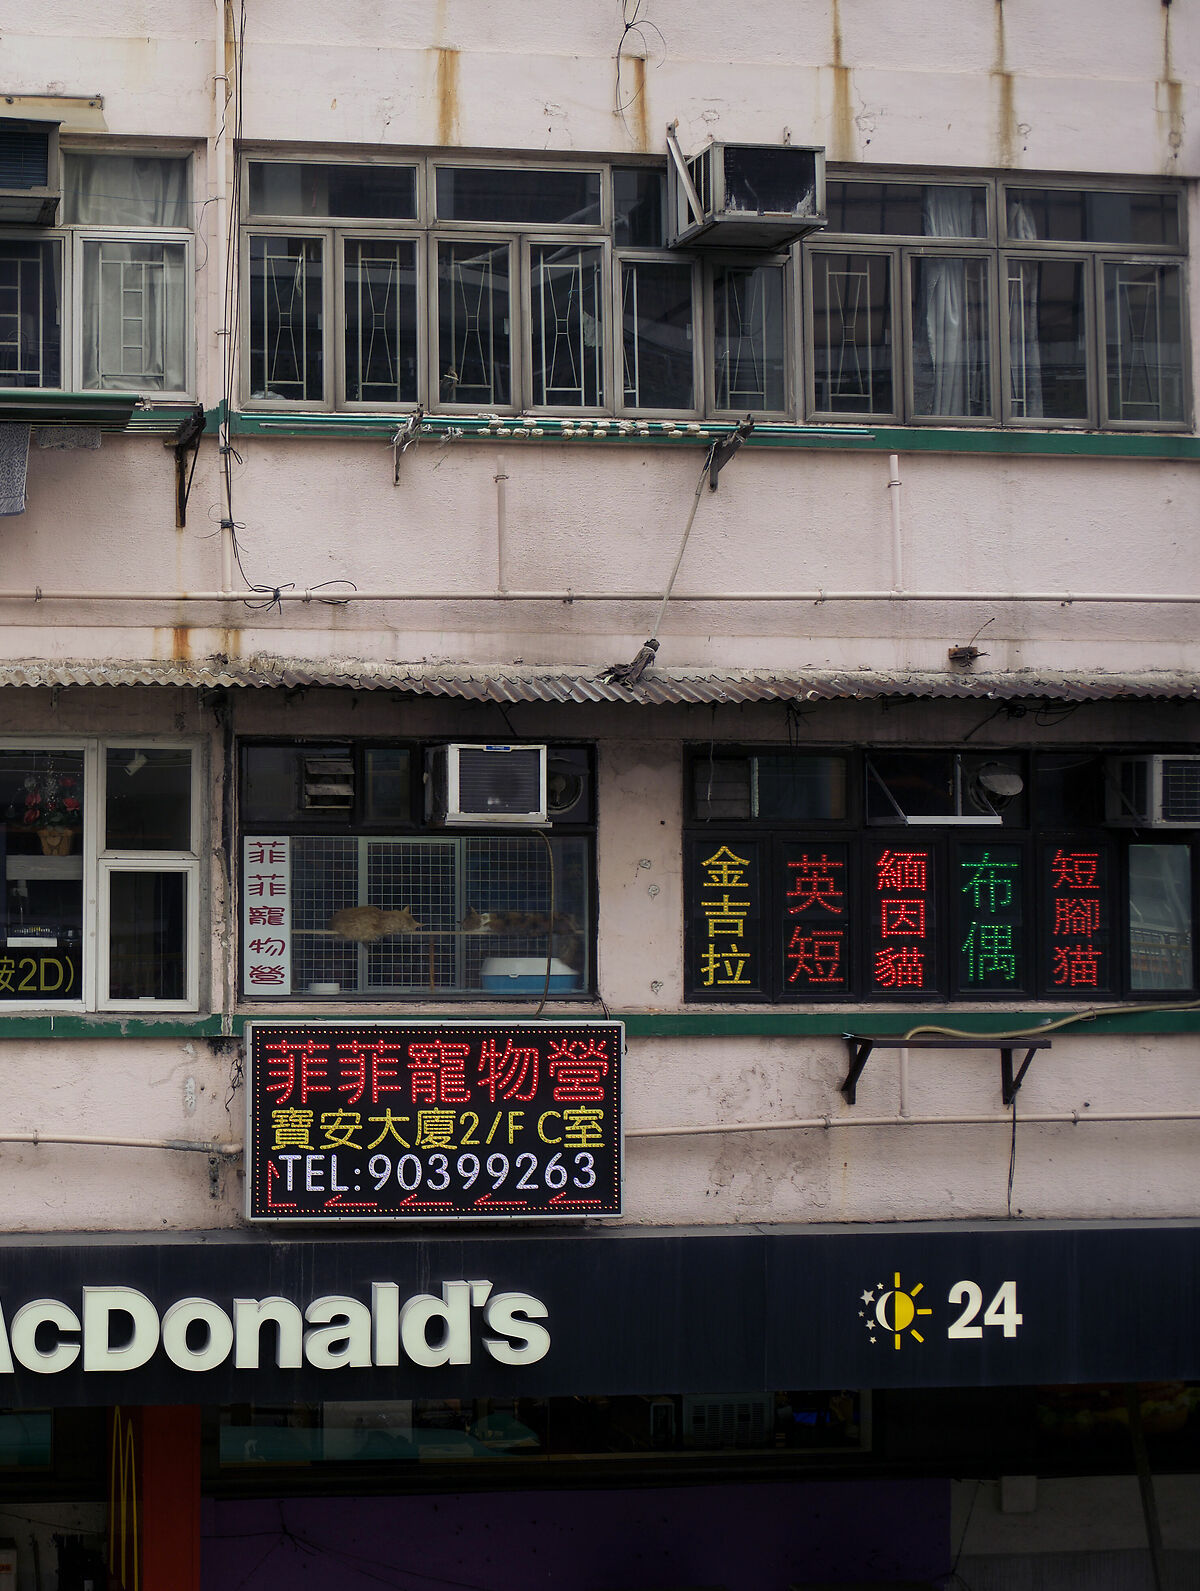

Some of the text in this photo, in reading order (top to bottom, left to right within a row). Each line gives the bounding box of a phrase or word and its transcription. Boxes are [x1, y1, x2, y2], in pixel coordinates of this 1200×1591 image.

[248, 841, 286, 986] 菲菲寵物營
[701, 845, 751, 986] 金吉拉
[786, 854, 844, 983] 英短
[874, 849, 928, 988] 緬因貓
[962, 852, 1019, 982] 布偶
[266, 1039, 609, 1104] 菲菲寵物營
[947, 1280, 1023, 1339] 24
